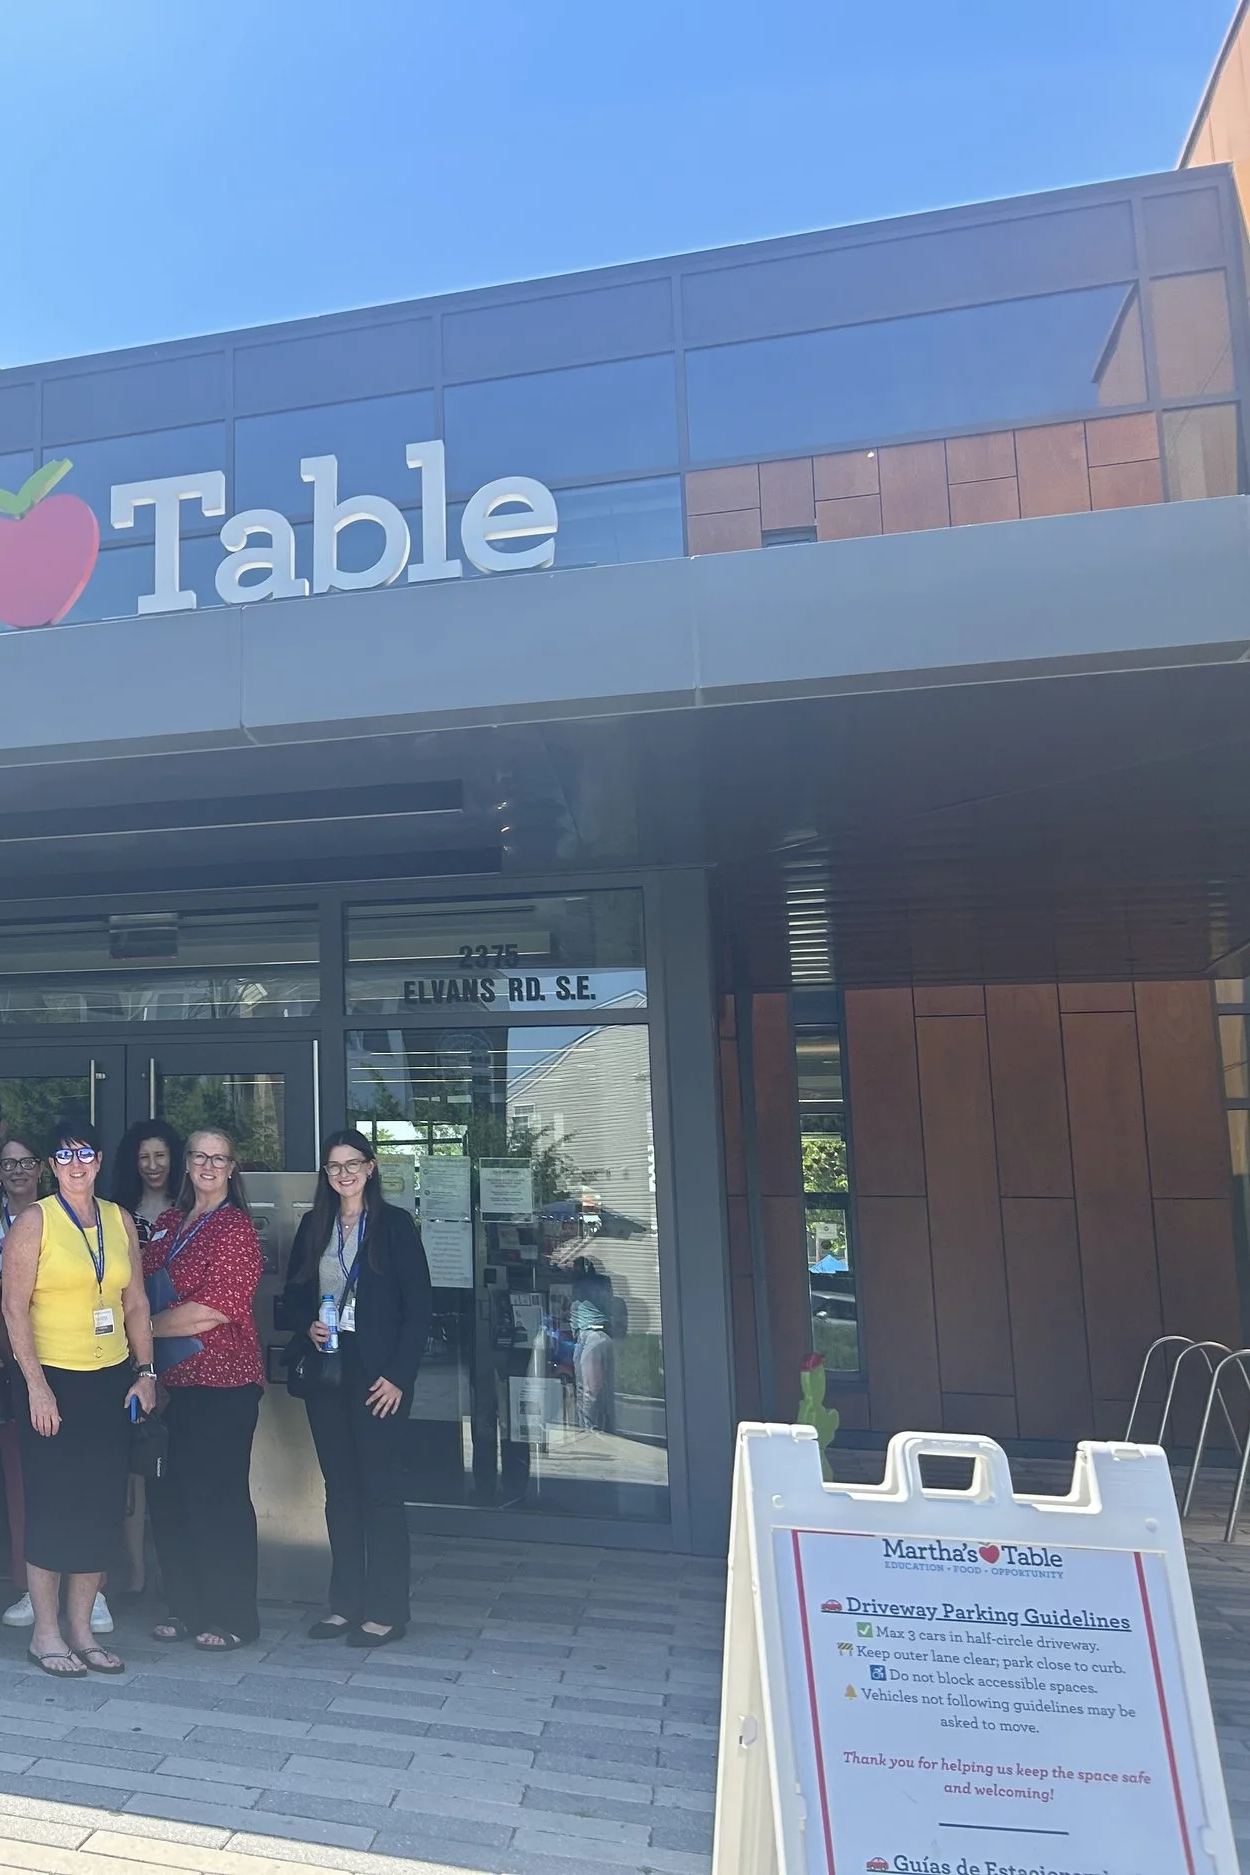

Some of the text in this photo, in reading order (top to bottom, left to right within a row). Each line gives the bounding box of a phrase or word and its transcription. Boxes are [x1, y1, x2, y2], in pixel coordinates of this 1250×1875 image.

[110, 439, 559, 615] Table
[459, 943, 520, 968] 2375
[403, 975, 597, 1005] ELVANS RD. S.E.
[882, 1538, 1063, 1568] Martha's Table
[884, 1561, 1064, 1580] EDUCATION FOOD OPPORTUNITY
[846, 1596, 1131, 1630] Driveway Parking Guidelines
[876, 1625, 1100, 1654] Max 3 cars in half-circle driveway.
[856, 1645, 1127, 1675] Keep outer lane clear; park close to curb.
[889, 1668, 1099, 1695] Do not block accessible spaces.
[861, 1687, 1137, 1719] Vehicles not following guidelines may be
[940, 1715, 1040, 1734] asked to move.
[843, 1751, 1152, 1785] Thank you for helping us keep the space safe
[944, 1782, 1055, 1803] and welcoming!
[893, 1854, 952, 1875] Guías
[956, 1857, 979, 1875] de
